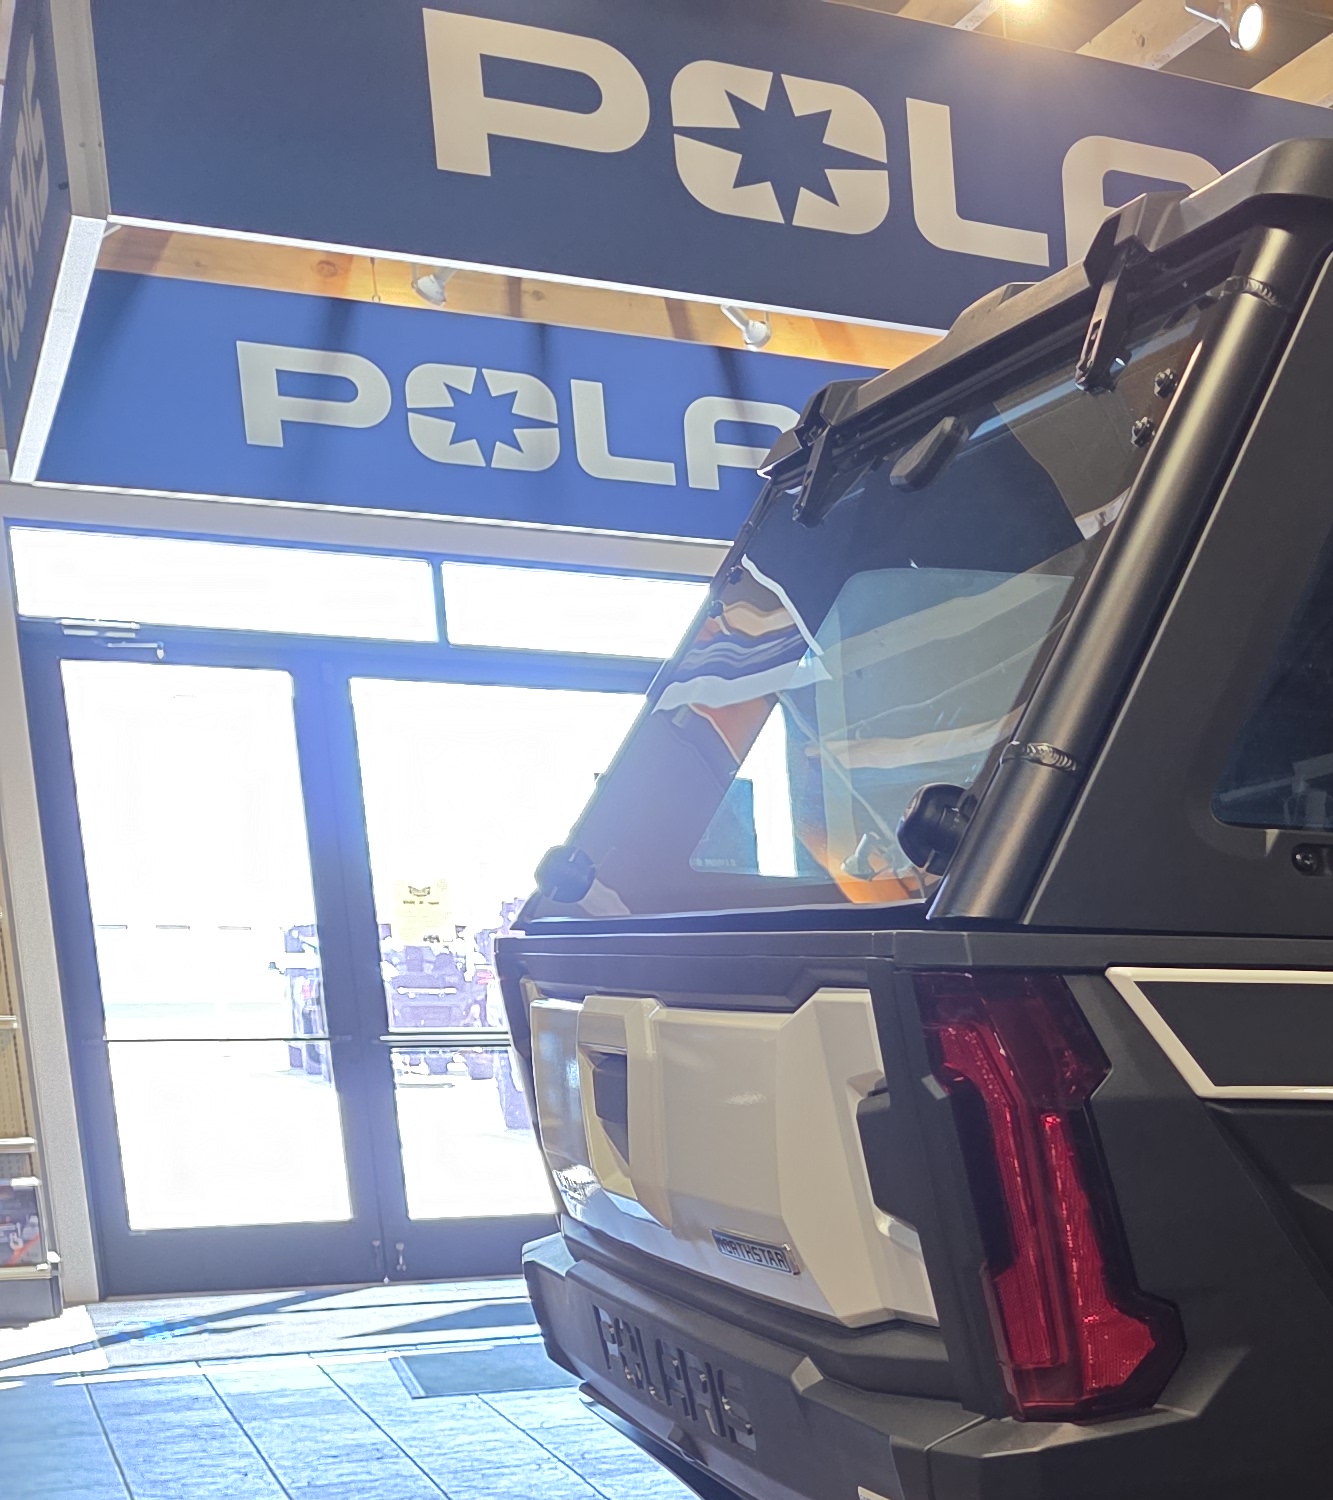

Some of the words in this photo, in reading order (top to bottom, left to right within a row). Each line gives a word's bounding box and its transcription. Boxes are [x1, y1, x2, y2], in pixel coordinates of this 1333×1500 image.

[423, 8, 1222, 267] POLA
[236, 341, 801, 490] POLA
[719, 1238, 788, 1269] NORTHSTAR
[593, 1304, 757, 1451] POLARIS
